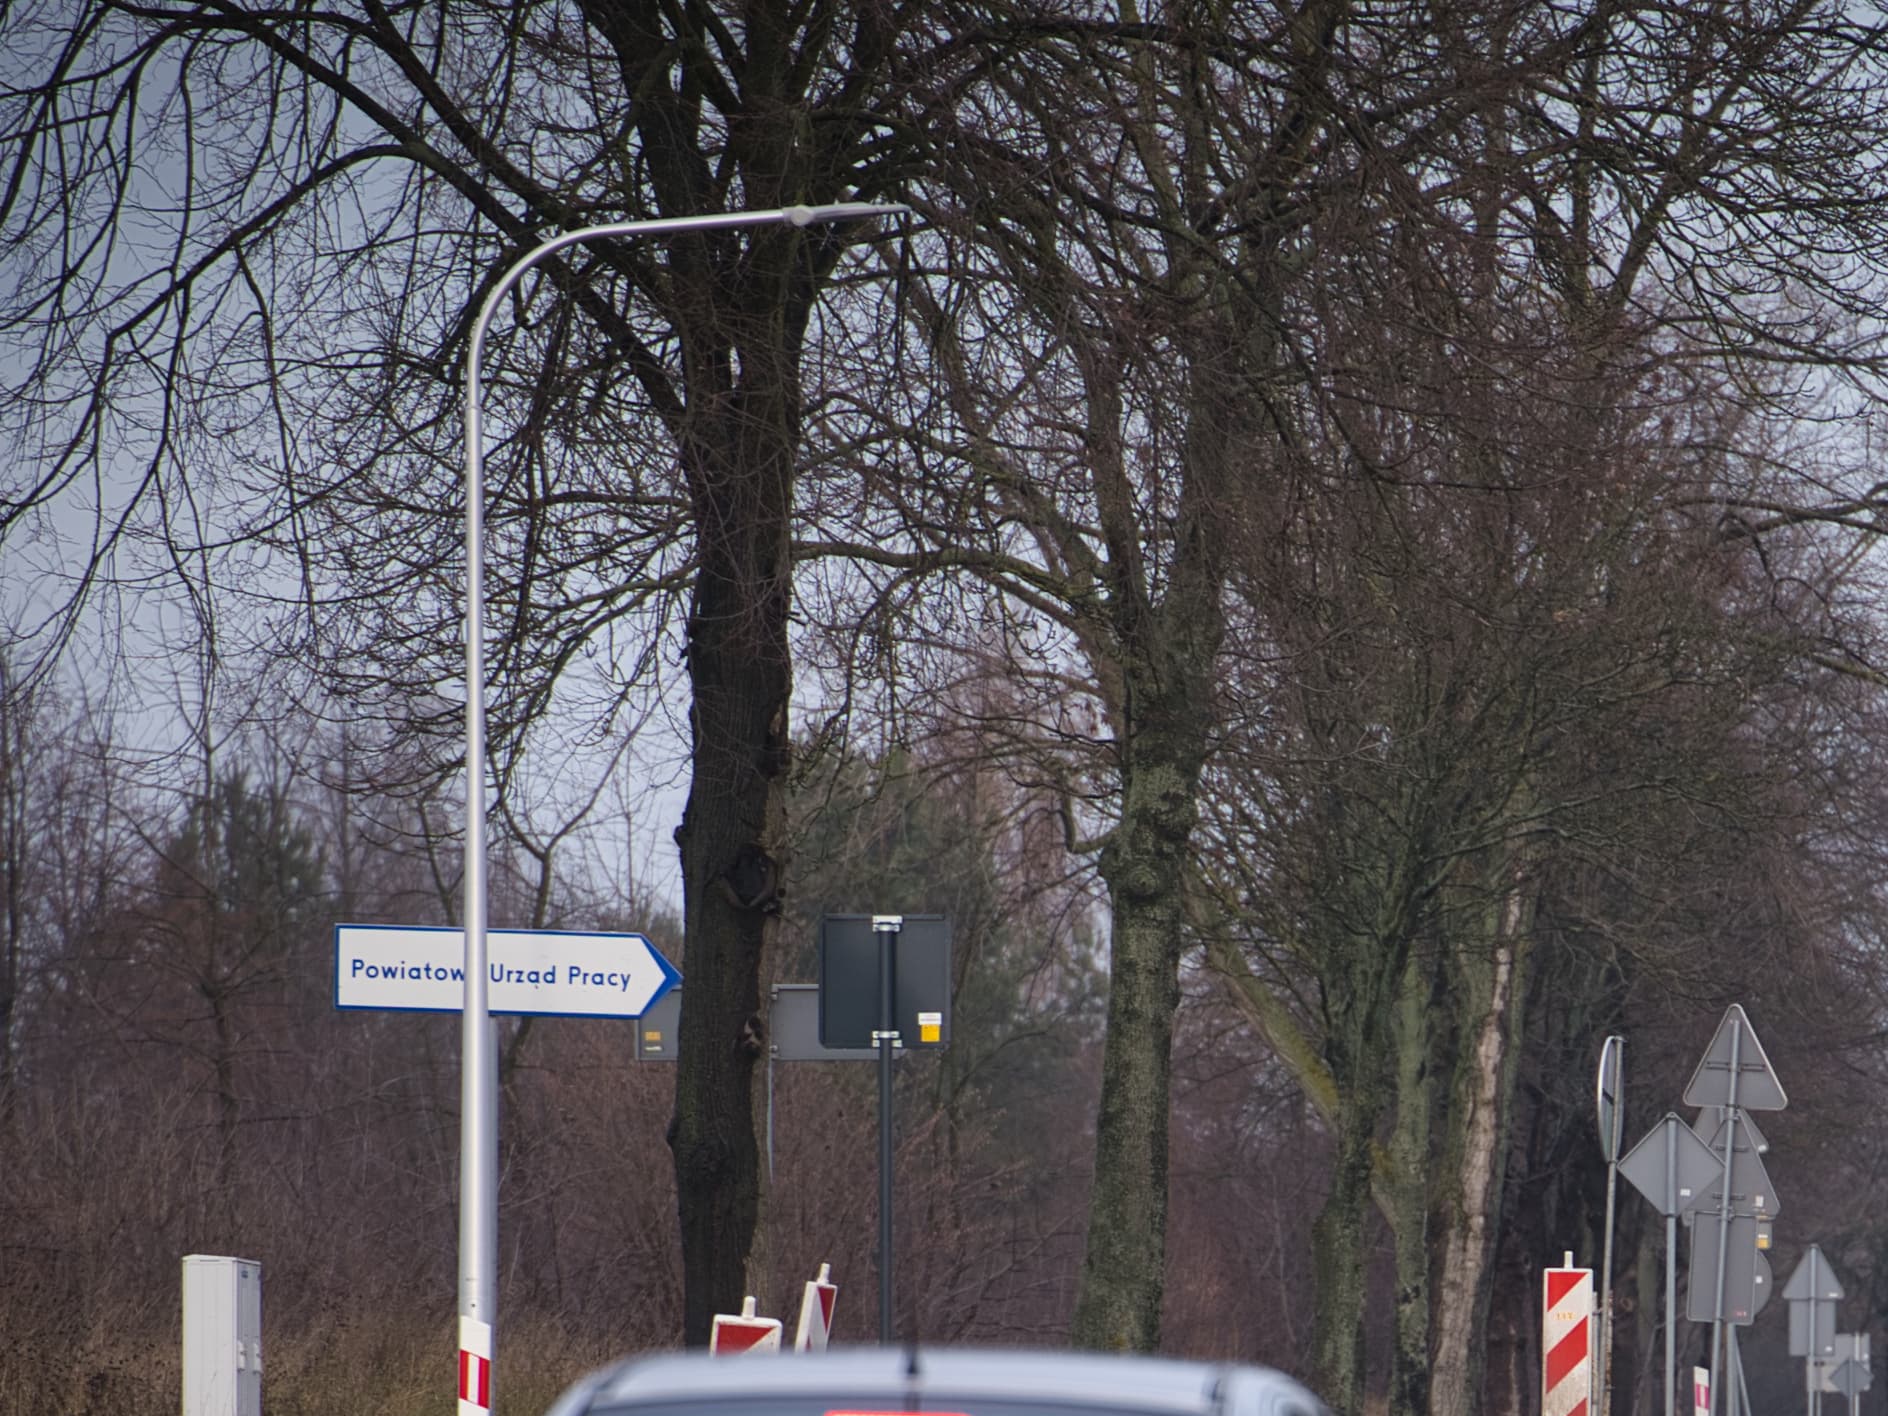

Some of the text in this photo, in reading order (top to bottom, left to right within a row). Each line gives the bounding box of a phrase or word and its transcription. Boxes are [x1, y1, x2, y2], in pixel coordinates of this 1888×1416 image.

[351, 959, 631, 992] Powiatow Urząd Pracy
